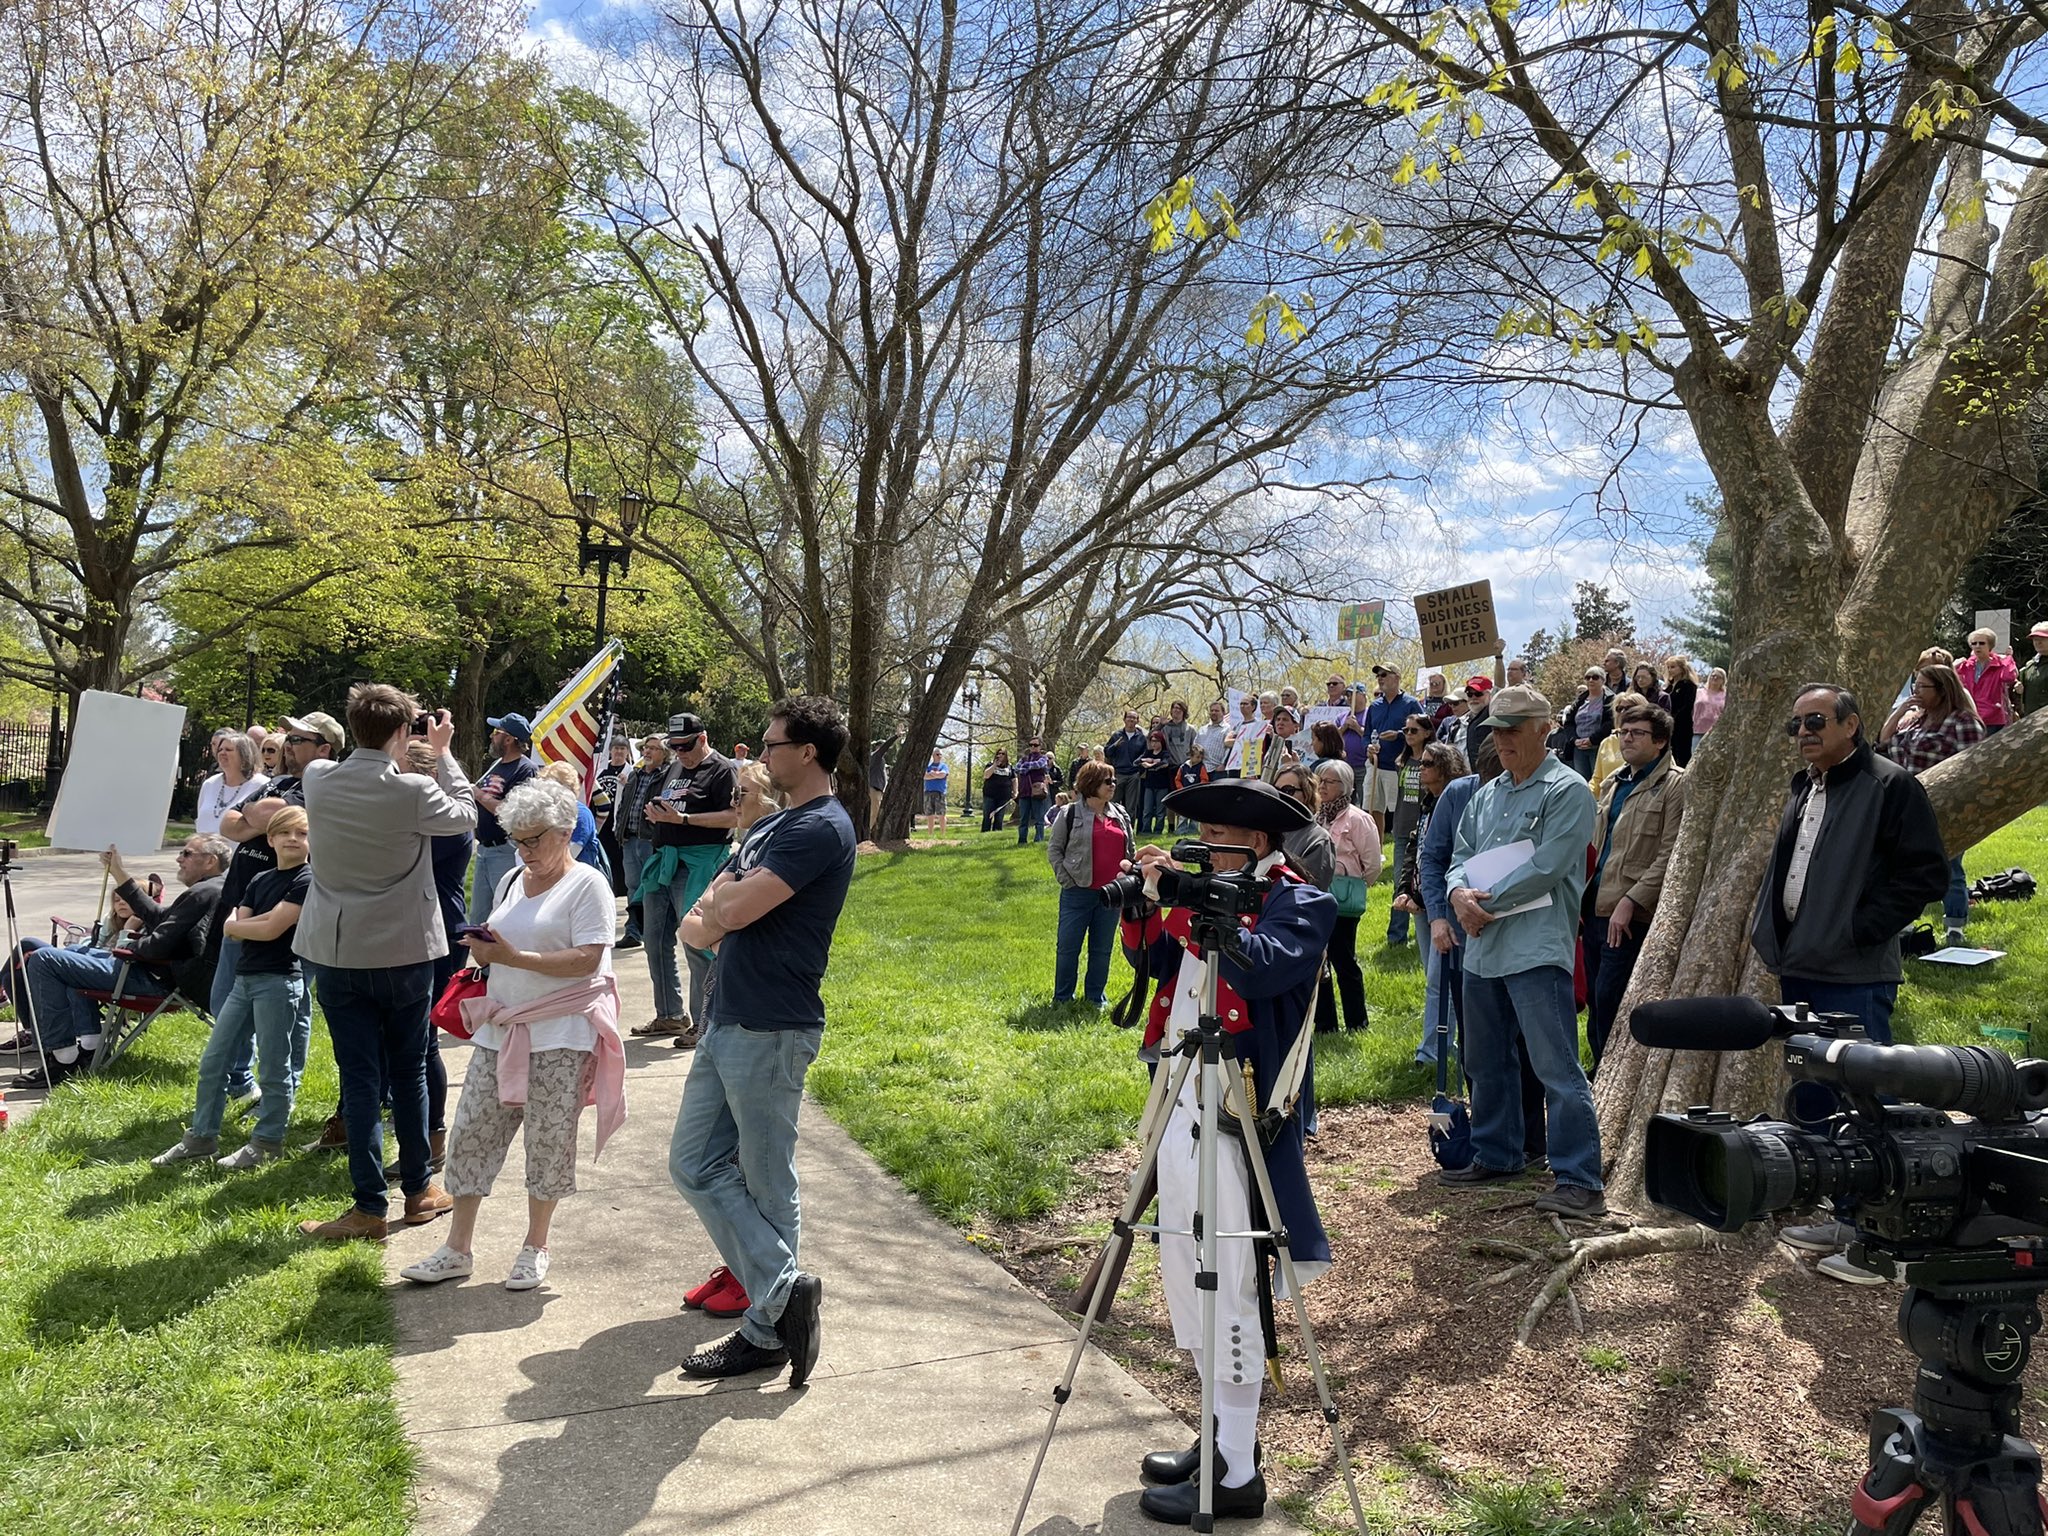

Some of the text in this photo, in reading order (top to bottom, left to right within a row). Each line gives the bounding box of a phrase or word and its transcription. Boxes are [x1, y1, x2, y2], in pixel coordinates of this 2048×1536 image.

[1427, 586, 1478, 608] SMALL
[1356, 612, 1375, 626] VAX
[1420, 600, 1489, 626] BUSINESS
[1354, 624, 1379, 638] FR
[1436, 618, 1481, 636] LIVES
[1432, 631, 1487, 653] MATTER
[1403, 795, 1419, 803] AGAIN
[238, 846, 269, 862] Joe Biden
[1787, 1054, 1804, 1065] JVC
[1988, 1181, 2007, 1194] JVC
